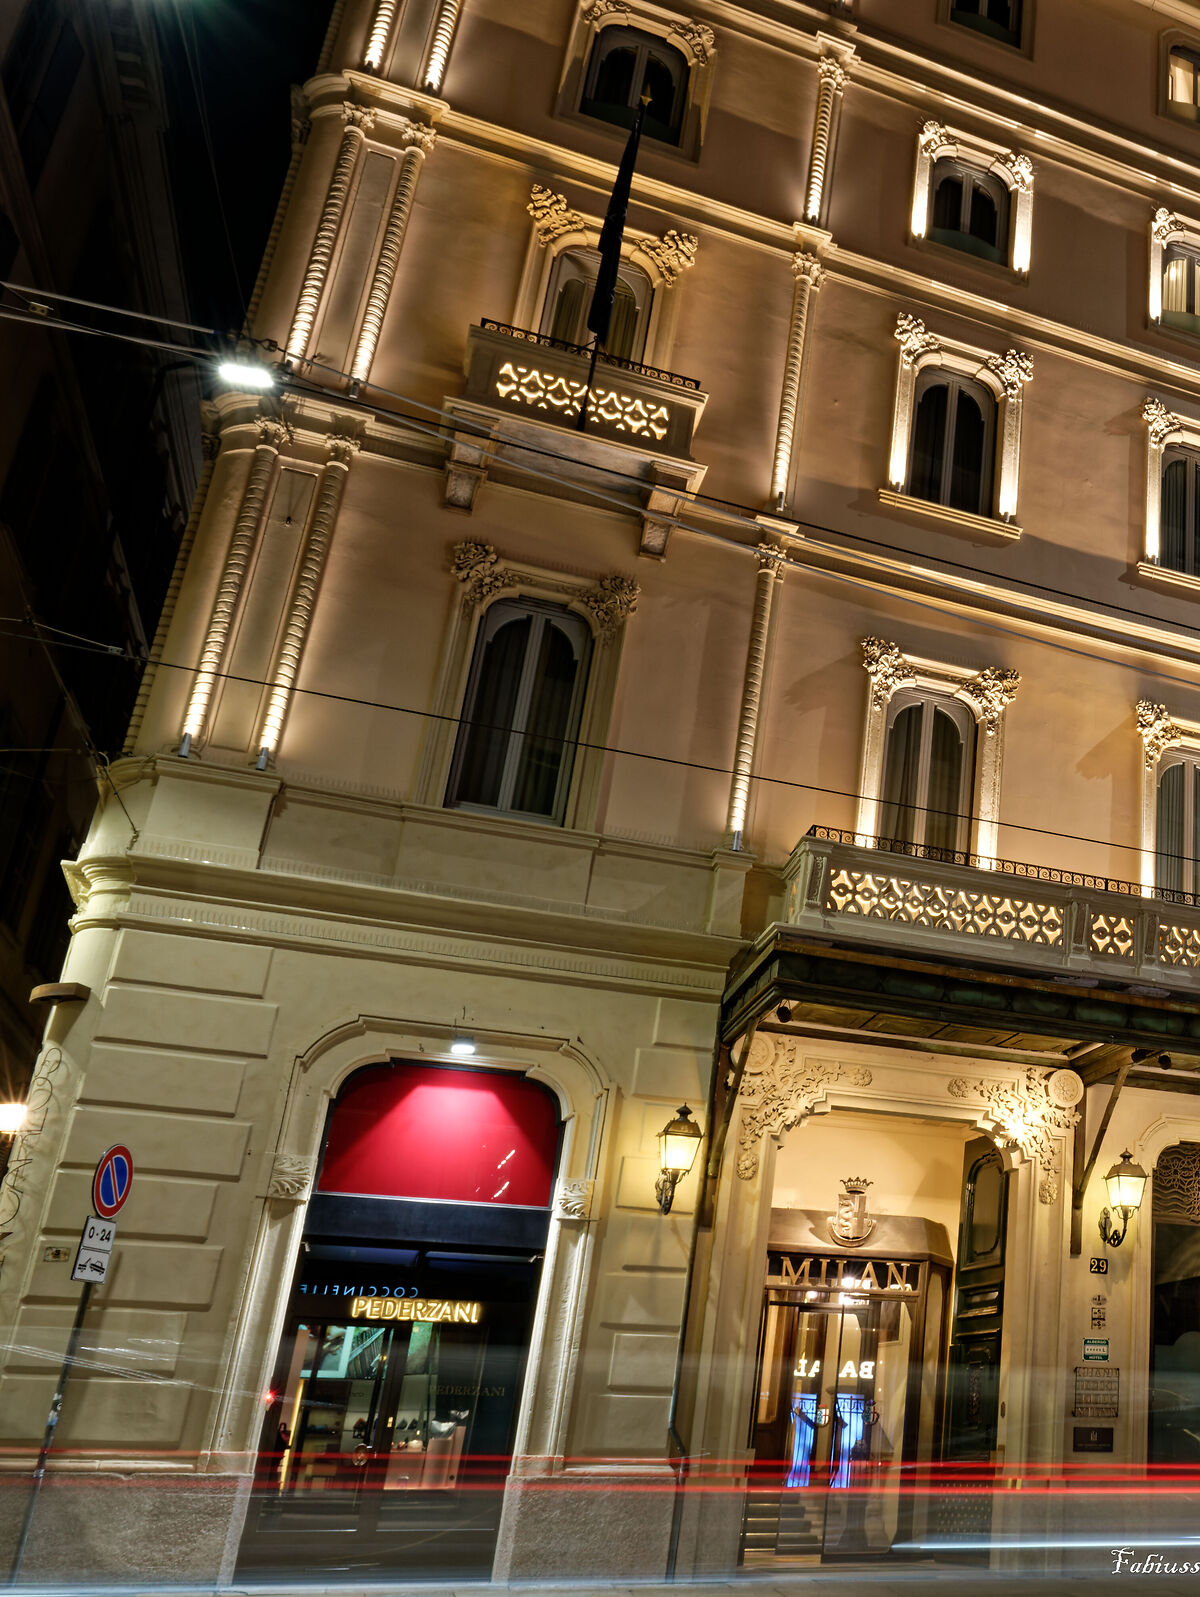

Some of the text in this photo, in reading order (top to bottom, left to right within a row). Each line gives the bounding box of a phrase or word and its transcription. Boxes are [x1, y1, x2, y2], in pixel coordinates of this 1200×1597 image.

[780, 1256, 913, 1292] MILAN
[1091, 1258, 1107, 1273] 29
[351, 1296, 481, 1324] PEDERZANI
